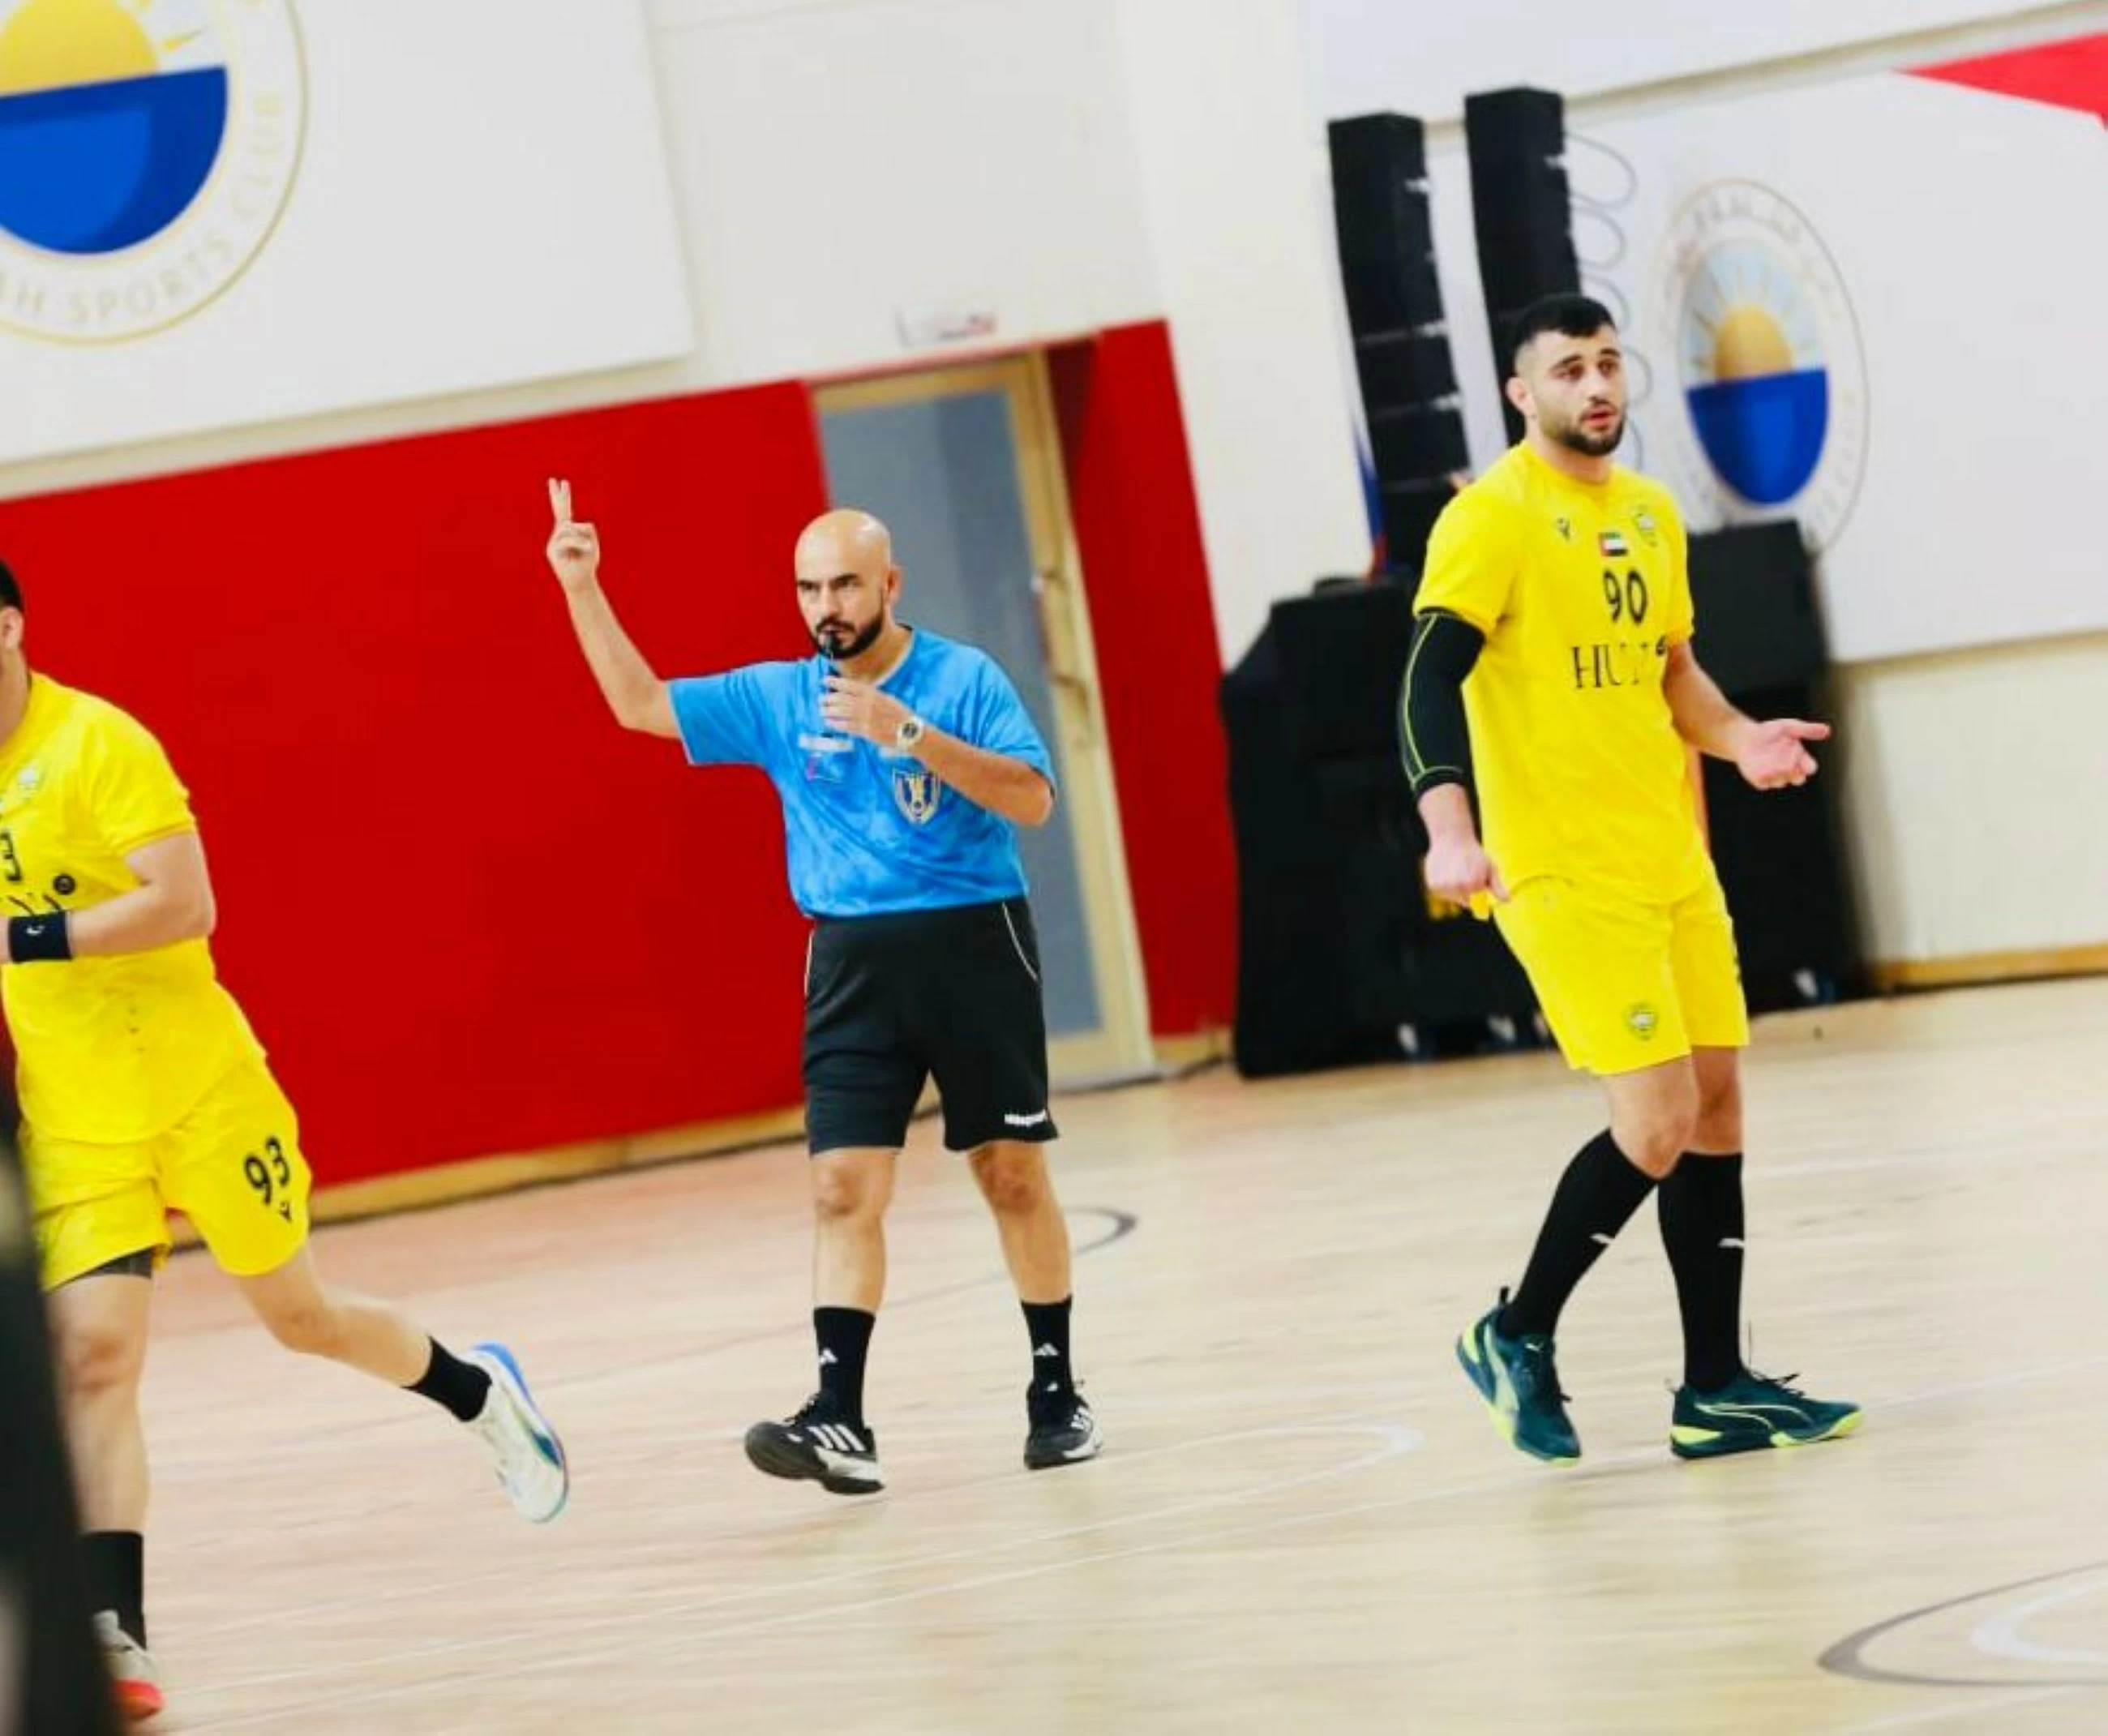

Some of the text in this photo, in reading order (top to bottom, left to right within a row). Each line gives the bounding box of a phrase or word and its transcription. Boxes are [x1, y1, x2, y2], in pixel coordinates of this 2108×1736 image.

[67, 229, 233, 324] SPORTS
[232, 93, 285, 220] CLUB
[1603, 569, 1647, 625] 90
[243, 1136, 290, 1205] 93
